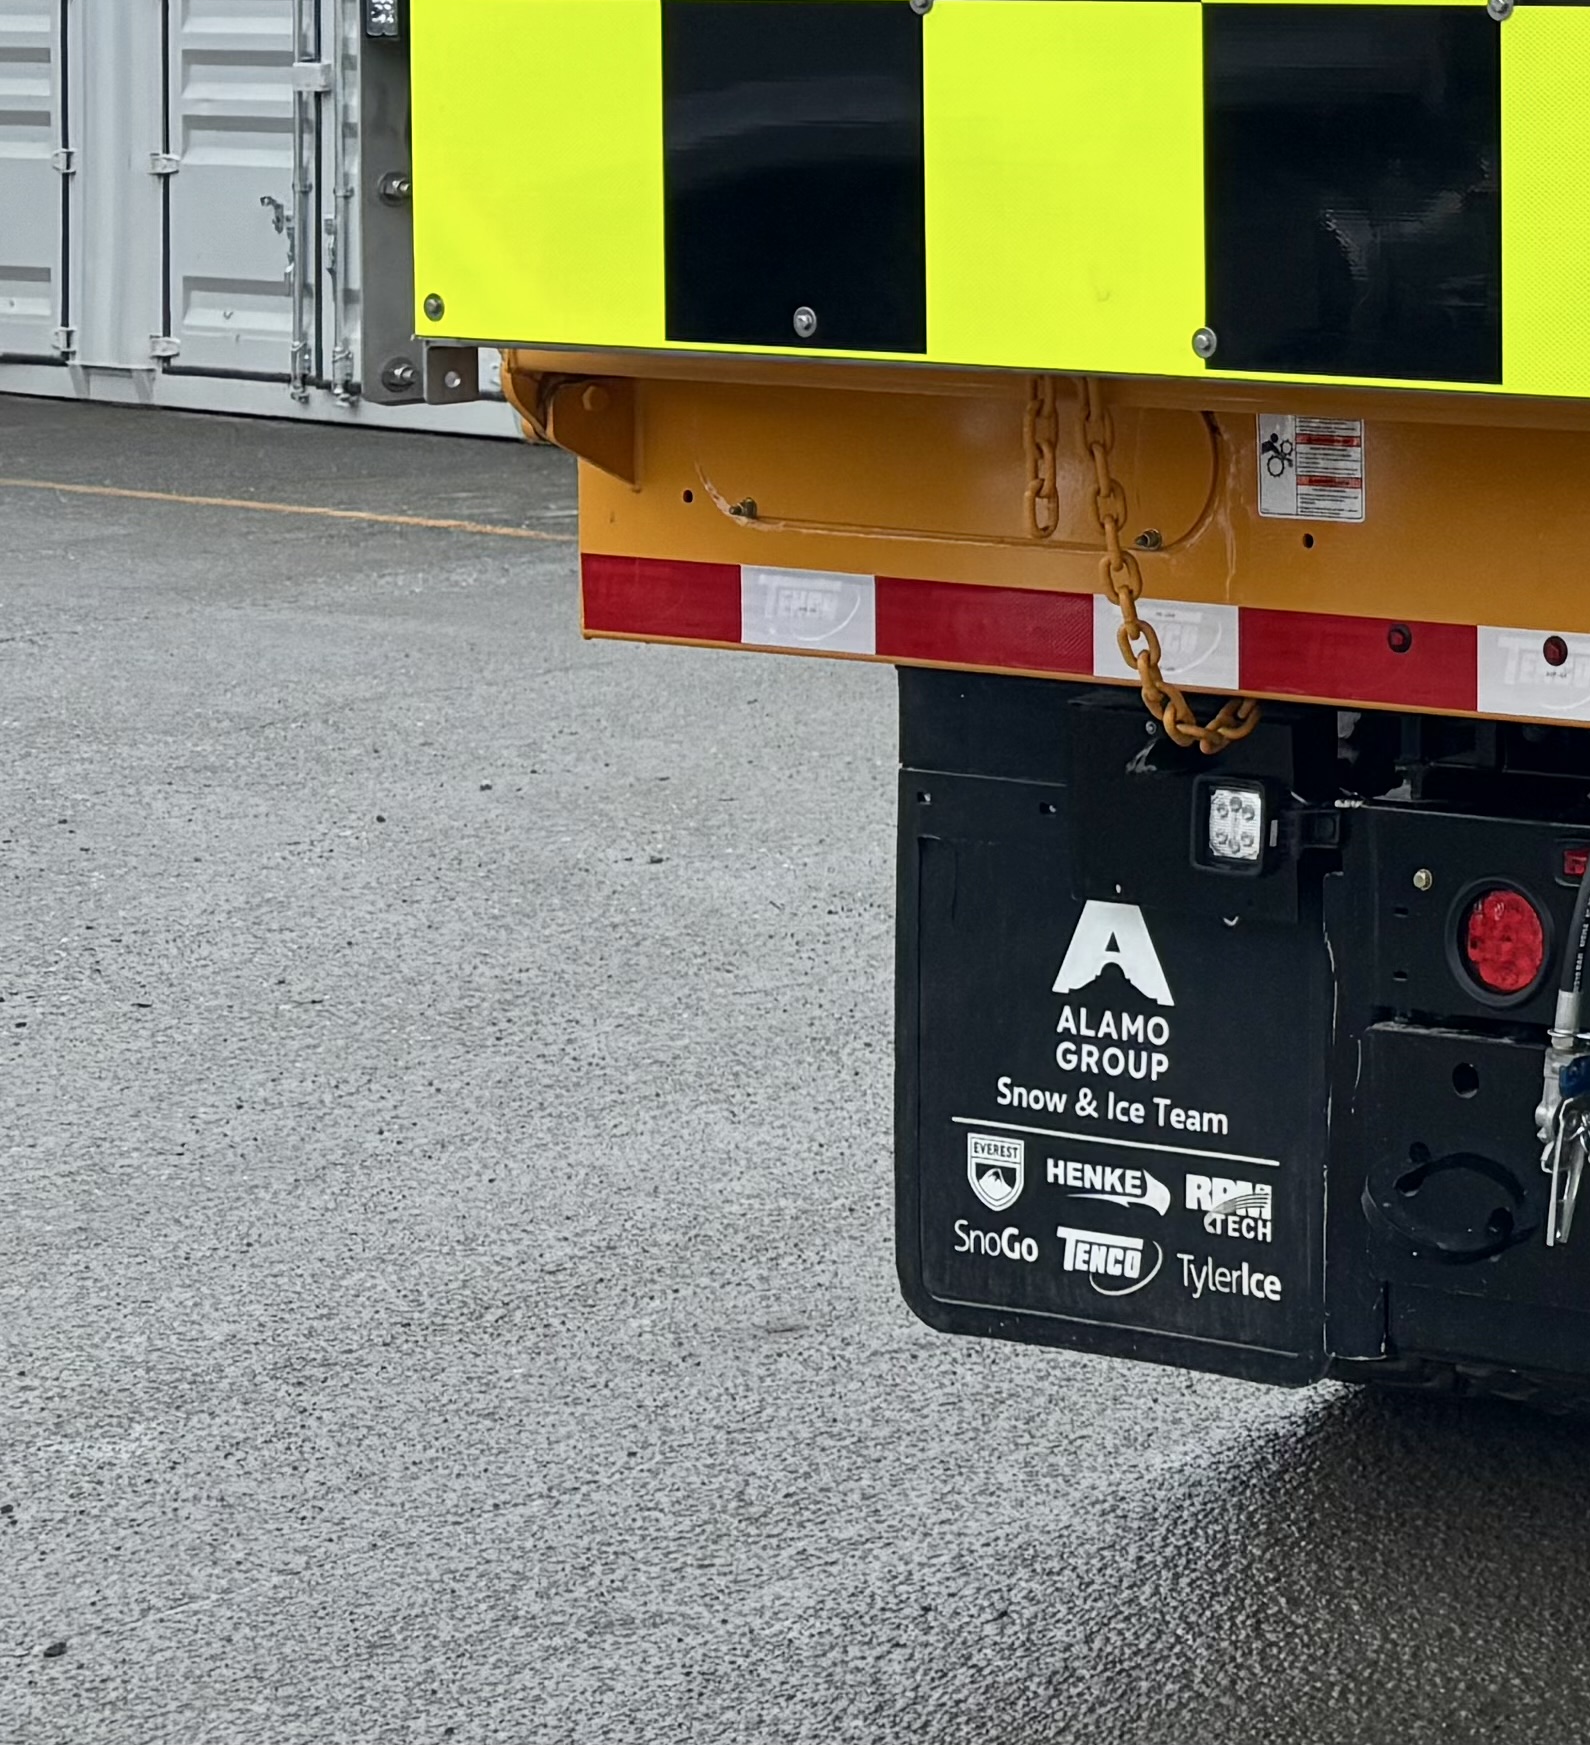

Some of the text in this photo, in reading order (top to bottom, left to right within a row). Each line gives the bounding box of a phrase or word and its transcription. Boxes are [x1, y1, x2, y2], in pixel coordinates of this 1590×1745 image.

[1056, 1005, 1170, 1046] ALAMO
[1056, 1041, 1170, 1082] GROUP
[996, 1076, 1229, 1136] Snow & Ice Team
[973, 1141, 1019, 1159] EVEREST
[1046, 1158, 1142, 1195] HENKE
[954, 1219, 1039, 1262] SnoGo
[1214, 1213, 1273, 1243] TECH
[1056, 1226, 1144, 1279] TENCO
[1176, 1253, 1282, 1301] TylerIce
